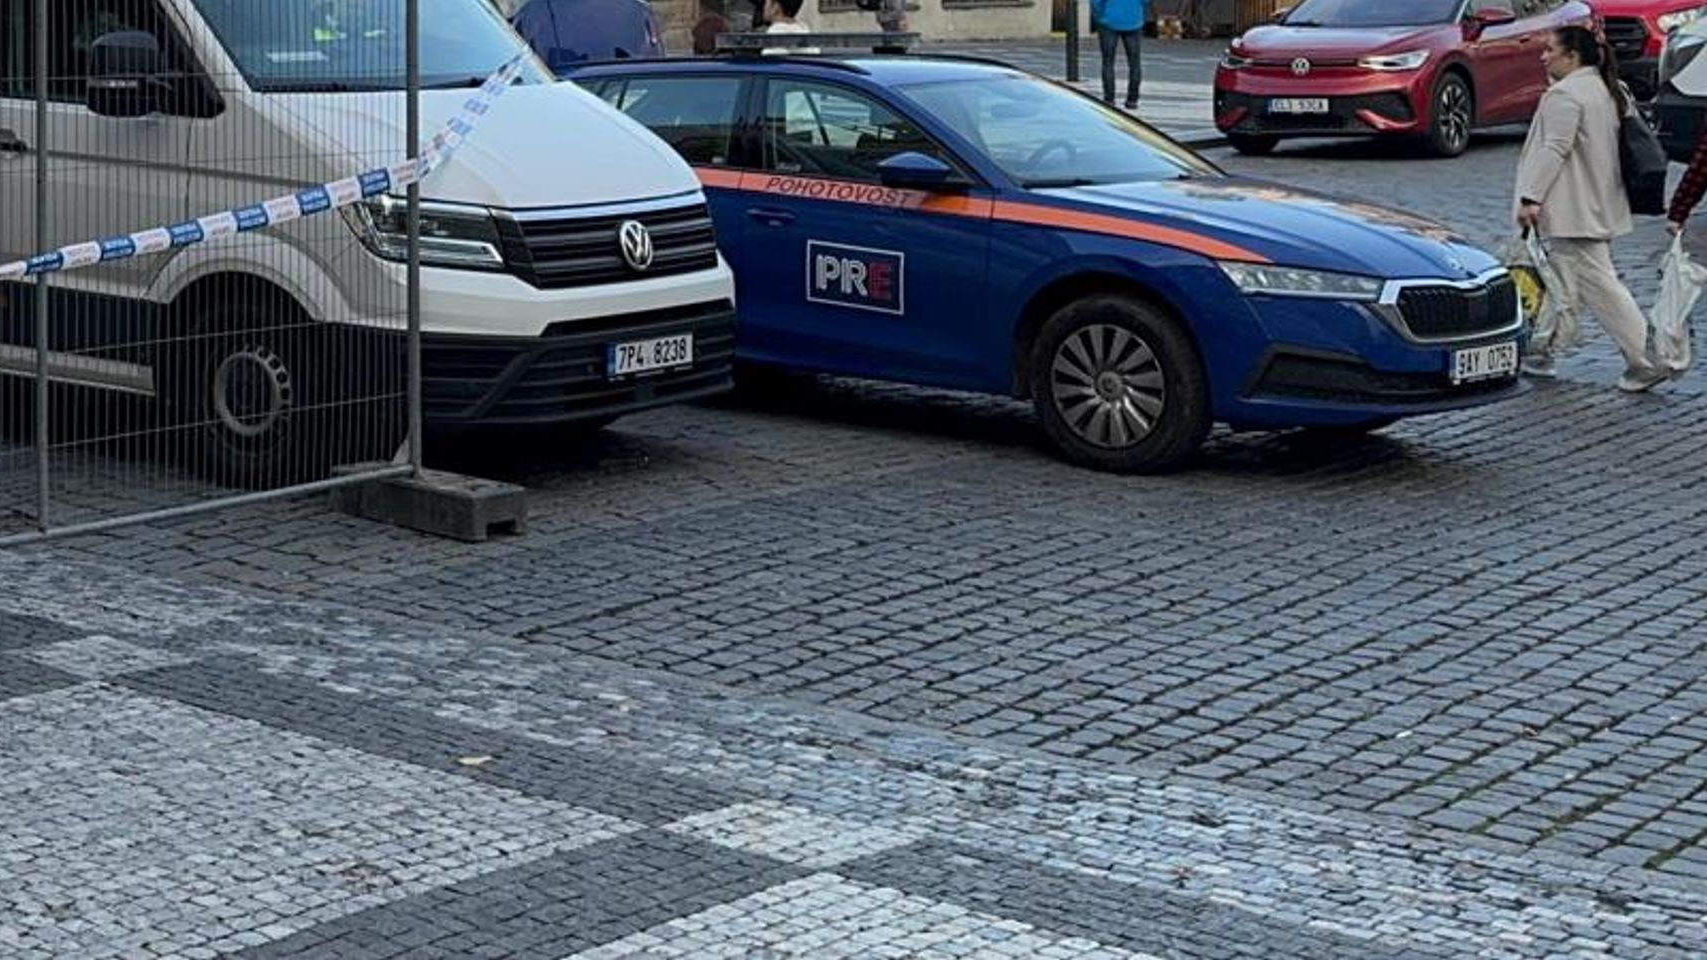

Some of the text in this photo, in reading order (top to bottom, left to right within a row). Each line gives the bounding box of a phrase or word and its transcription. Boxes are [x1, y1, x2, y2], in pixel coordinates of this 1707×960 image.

[766, 177, 910, 204] POHOTOVOST
[815, 253, 892, 300] PRE
[619, 337, 686, 370] 7P4 8238
